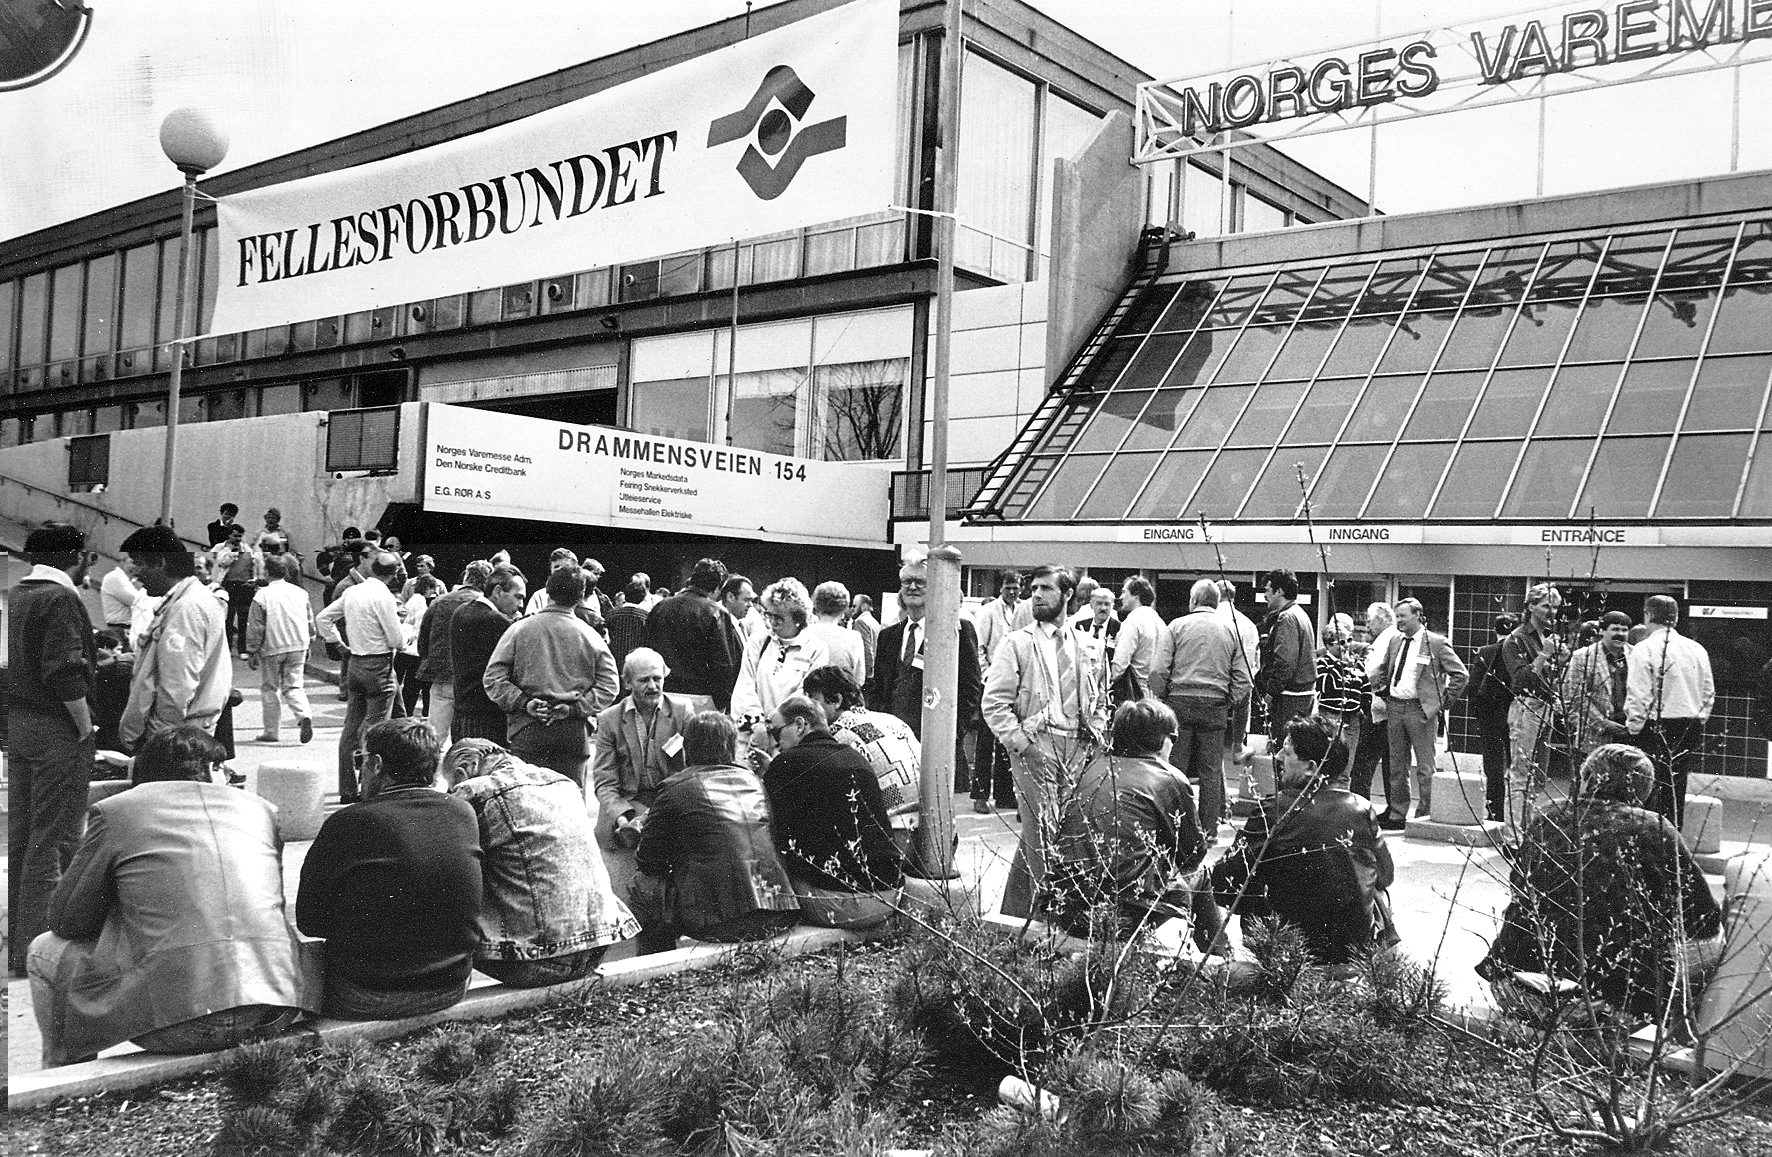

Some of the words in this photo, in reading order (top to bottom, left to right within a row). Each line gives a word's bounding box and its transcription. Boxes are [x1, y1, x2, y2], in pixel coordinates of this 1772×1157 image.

[1182, 41, 1438, 136] NORGES
[237, 131, 678, 287] FELLESFORBUNDET
[436, 444, 467, 457] Norges
[468, 448, 512, 462] Varemesse
[513, 454, 532, 464] Adm.
[558, 429, 762, 476] DRAMMENSVEIEN
[774, 461, 807, 482] 154
[435, 458, 453, 468] Den
[454, 461, 483, 472] Norske
[484, 464, 527, 476] Creditbank
[620, 467, 645, 479] Norges
[645, 470, 688, 483] Markedsdata
[434, 485, 452, 496] E.G.
[619, 479, 643, 491] Feiring
[643, 482, 698, 496] Snekkerverksted
[618, 504, 660, 517] Messehallen
[660, 508, 693, 520] Elektriske
[1143, 528, 1194, 540] EINGANG
[1328, 528, 1390, 540] INNGANG
[1541, 529, 1626, 543] ENTRANCE
